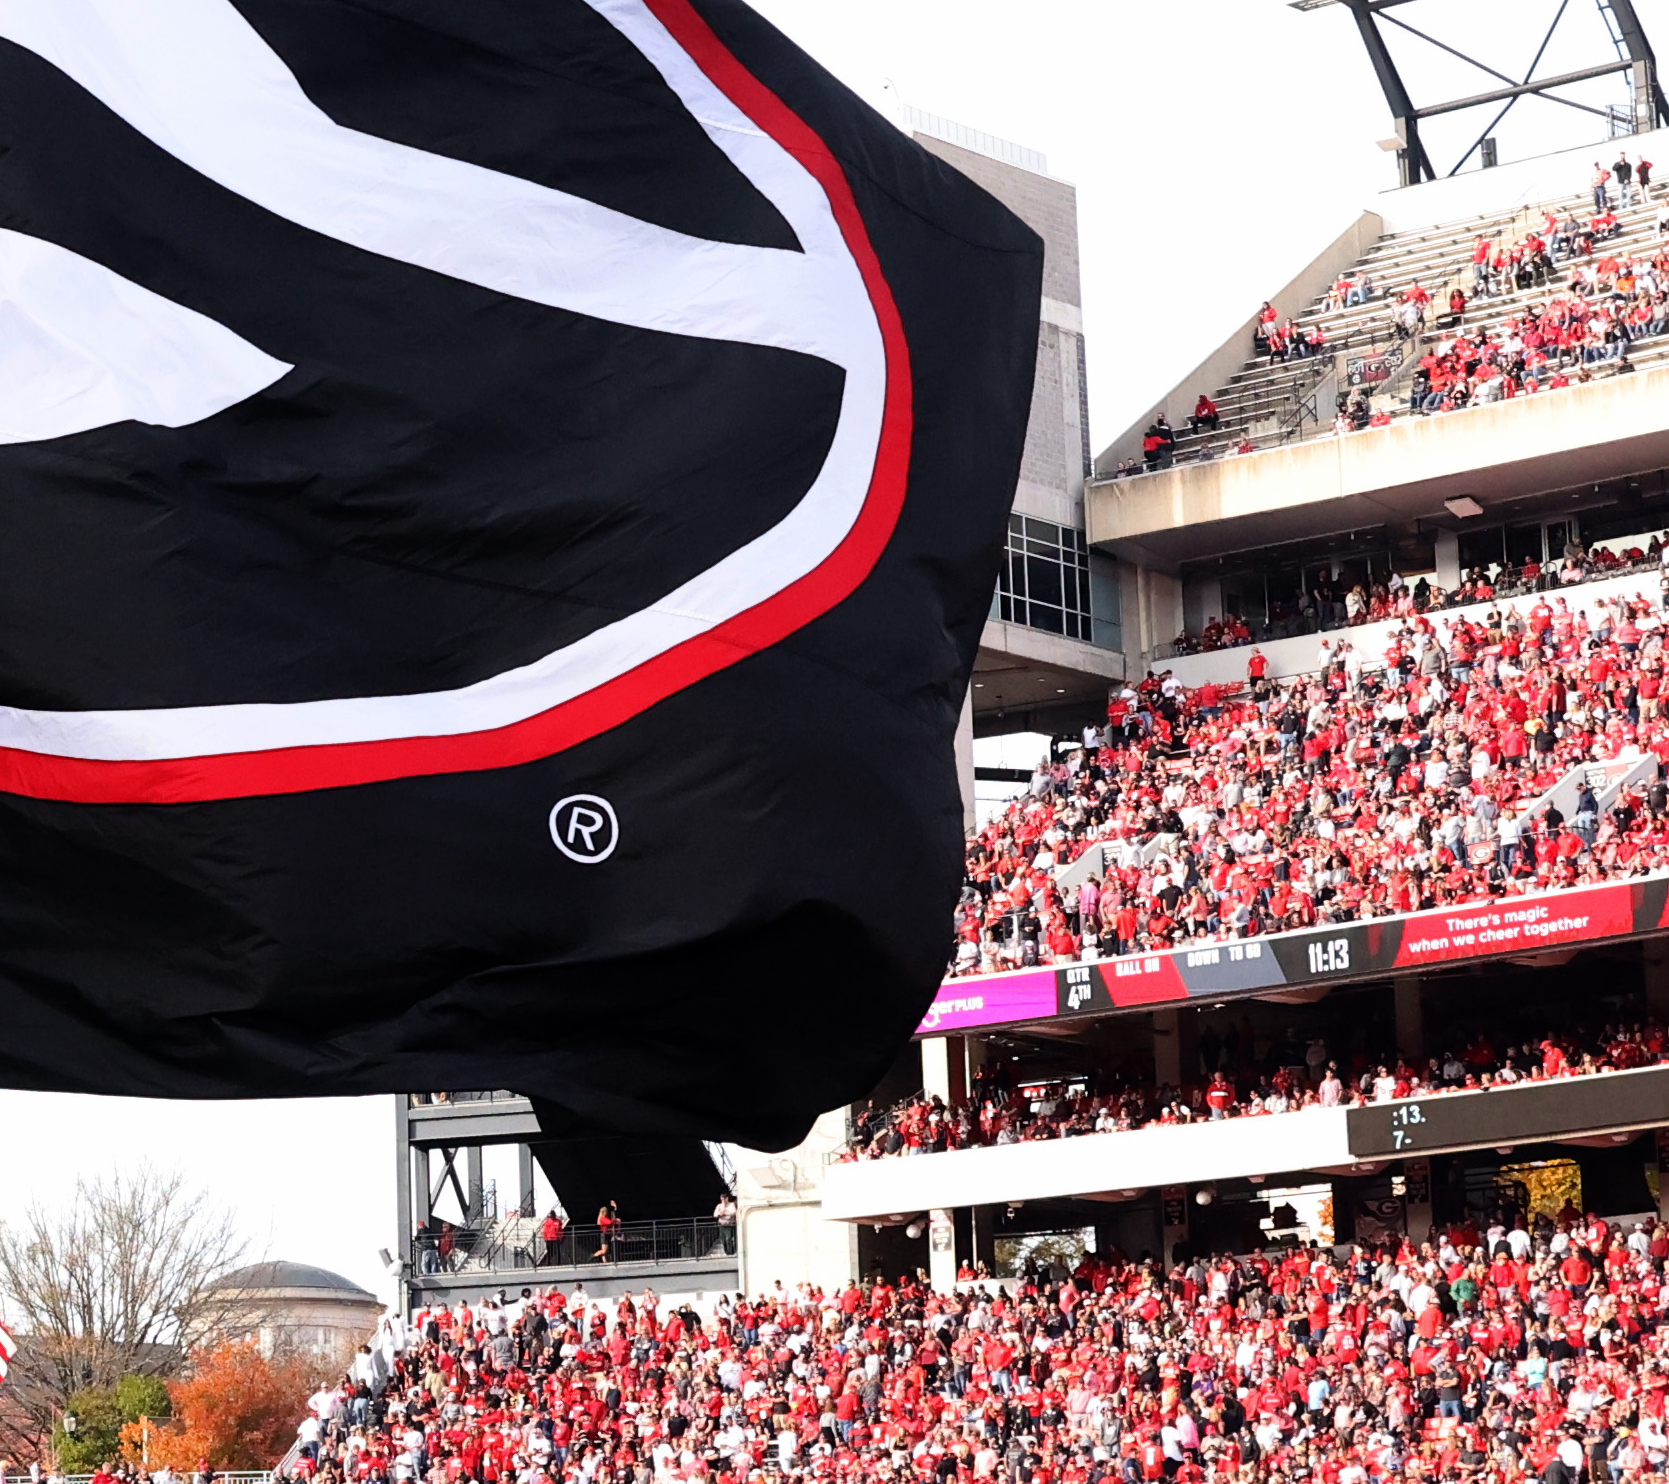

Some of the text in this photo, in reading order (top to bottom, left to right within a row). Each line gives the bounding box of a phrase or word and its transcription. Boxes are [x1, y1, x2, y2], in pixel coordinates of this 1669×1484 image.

[1447, 906, 1549, 932] There's magic
[1409, 915, 1589, 953] when we cheer together
[1115, 957, 1160, 977] BALL ON
[1187, 943, 1261, 967] DOWN TO GO
[1309, 936, 1349, 973] 11:13
[1067, 966, 1090, 983] QTR
[1066, 985, 1091, 1010] 4TH
